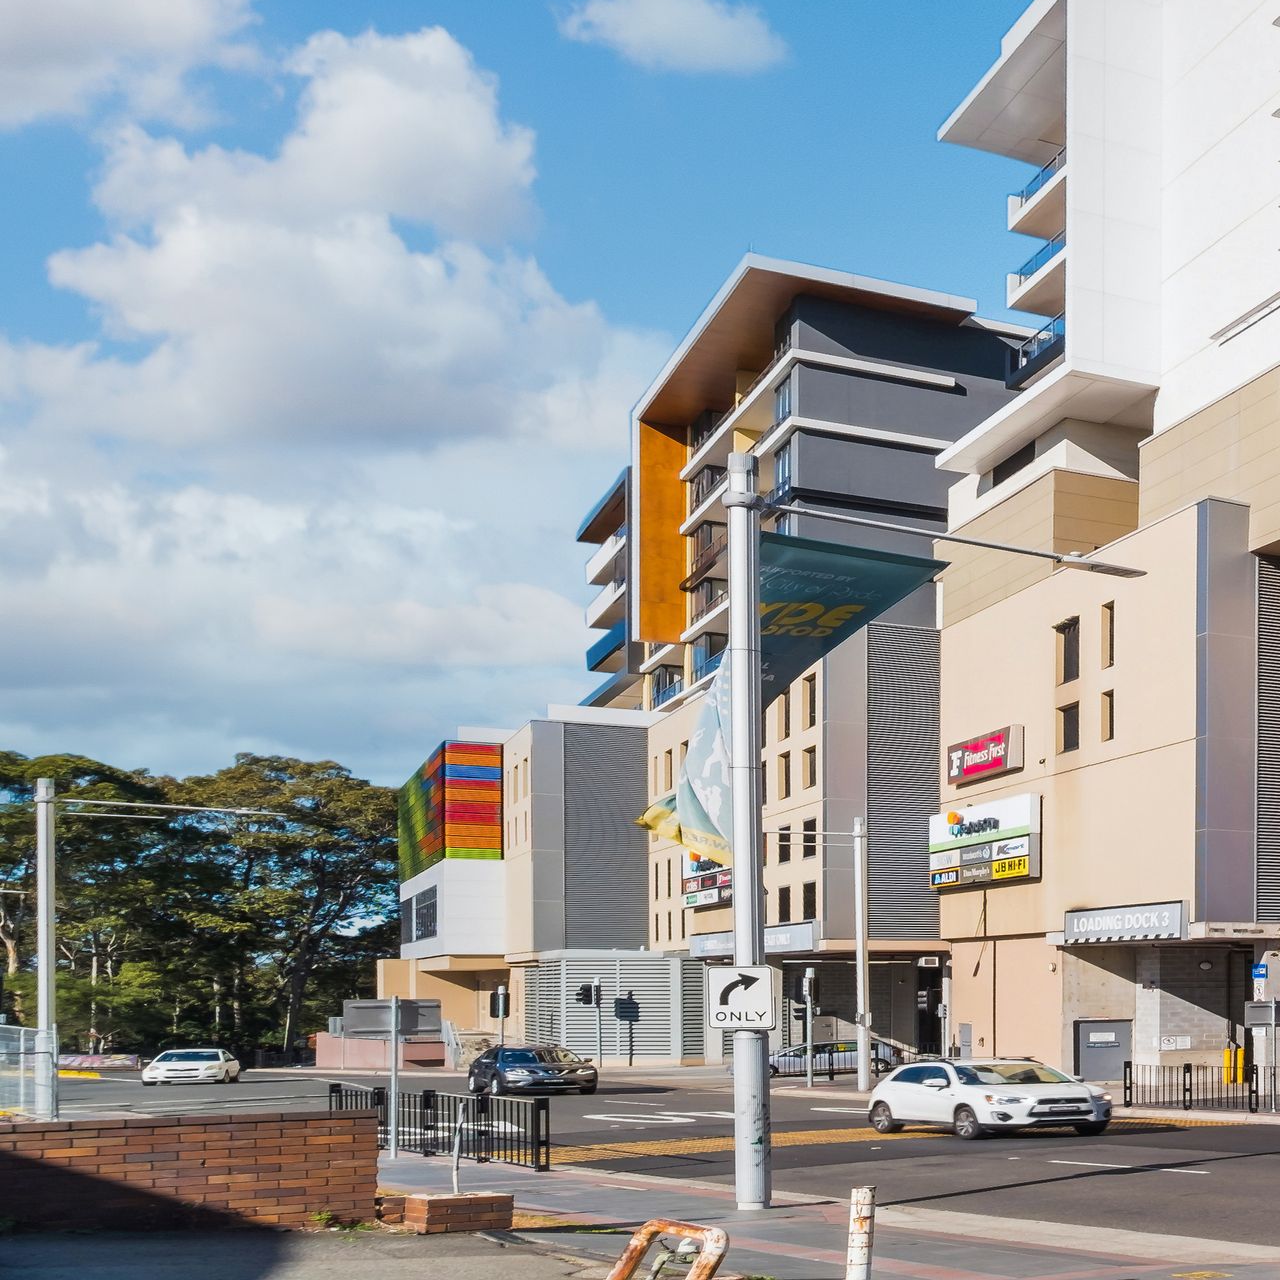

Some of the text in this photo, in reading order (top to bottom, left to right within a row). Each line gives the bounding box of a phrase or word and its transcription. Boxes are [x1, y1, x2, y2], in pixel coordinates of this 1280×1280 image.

[760, 602, 866, 628] YDE
[964, 751, 988, 769] Fitness
[989, 742, 1006, 761] First
[995, 862, 1006, 873] JB
[941, 871, 957, 883] ALDI
[1073, 911, 1170, 933] LOADING DOCK 3
[715, 1011, 767, 1022] ONLY
